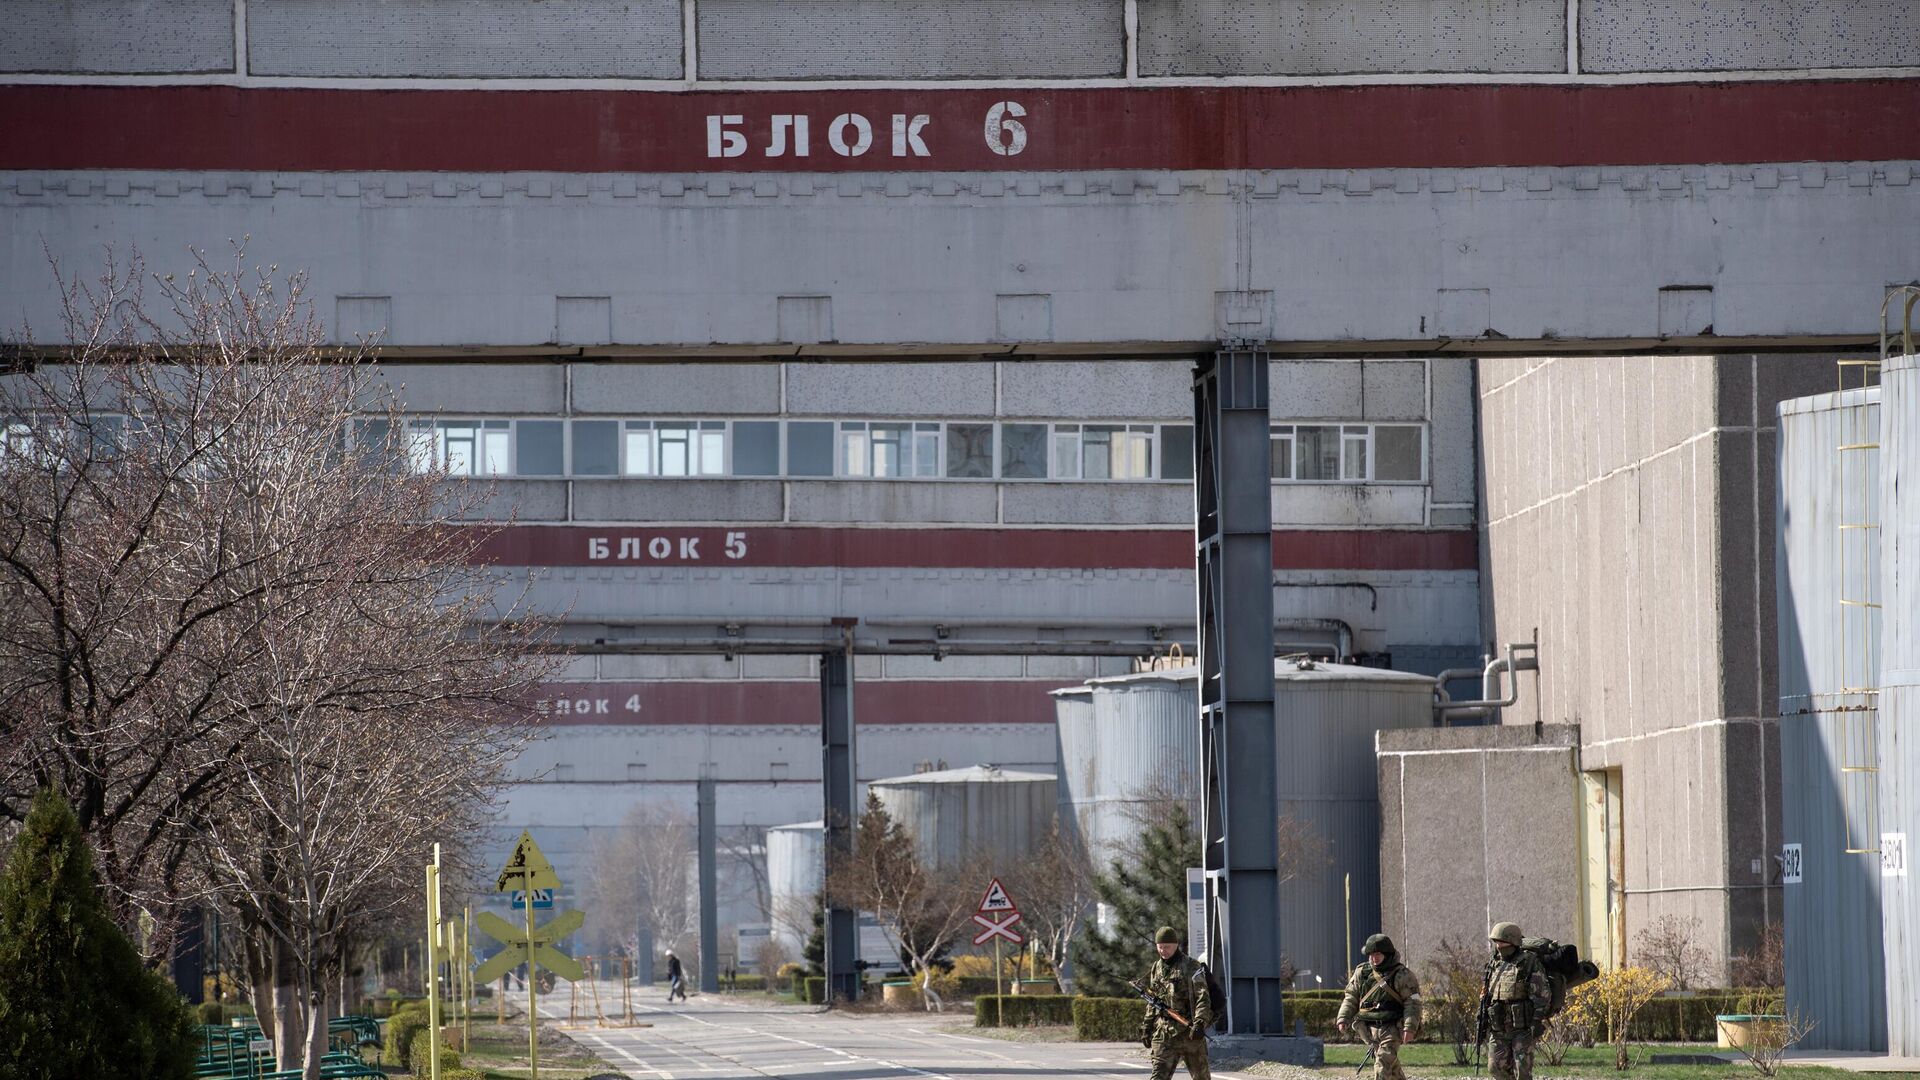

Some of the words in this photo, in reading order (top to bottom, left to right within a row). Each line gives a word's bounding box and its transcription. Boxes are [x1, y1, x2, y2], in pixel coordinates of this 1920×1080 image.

[706, 113, 932, 158] БЛОК
[984, 101, 1028, 156] 6
[588, 536, 700, 560] БЛОК
[724, 531, 748, 560] 5
[624, 693, 642, 713] 4
